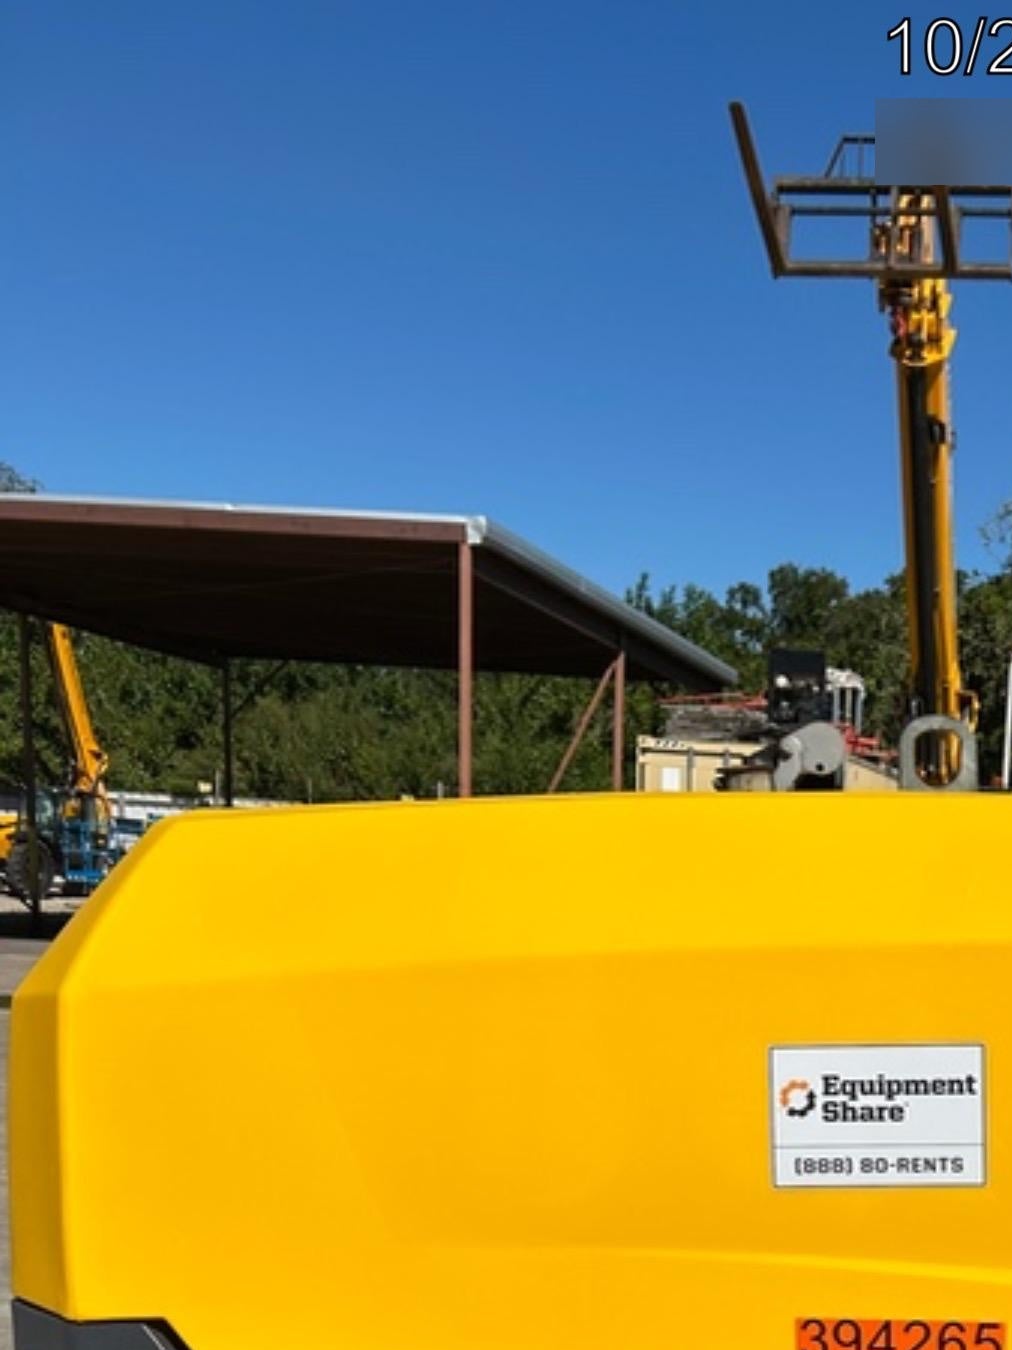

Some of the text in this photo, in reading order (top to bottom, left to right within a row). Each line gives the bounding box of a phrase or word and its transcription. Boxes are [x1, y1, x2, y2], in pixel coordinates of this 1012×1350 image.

[821, 1074, 978, 1100] Equipment
[821, 1101, 905, 1123] Share
[794, 1157, 964, 1176] (888) 80-RENTS
